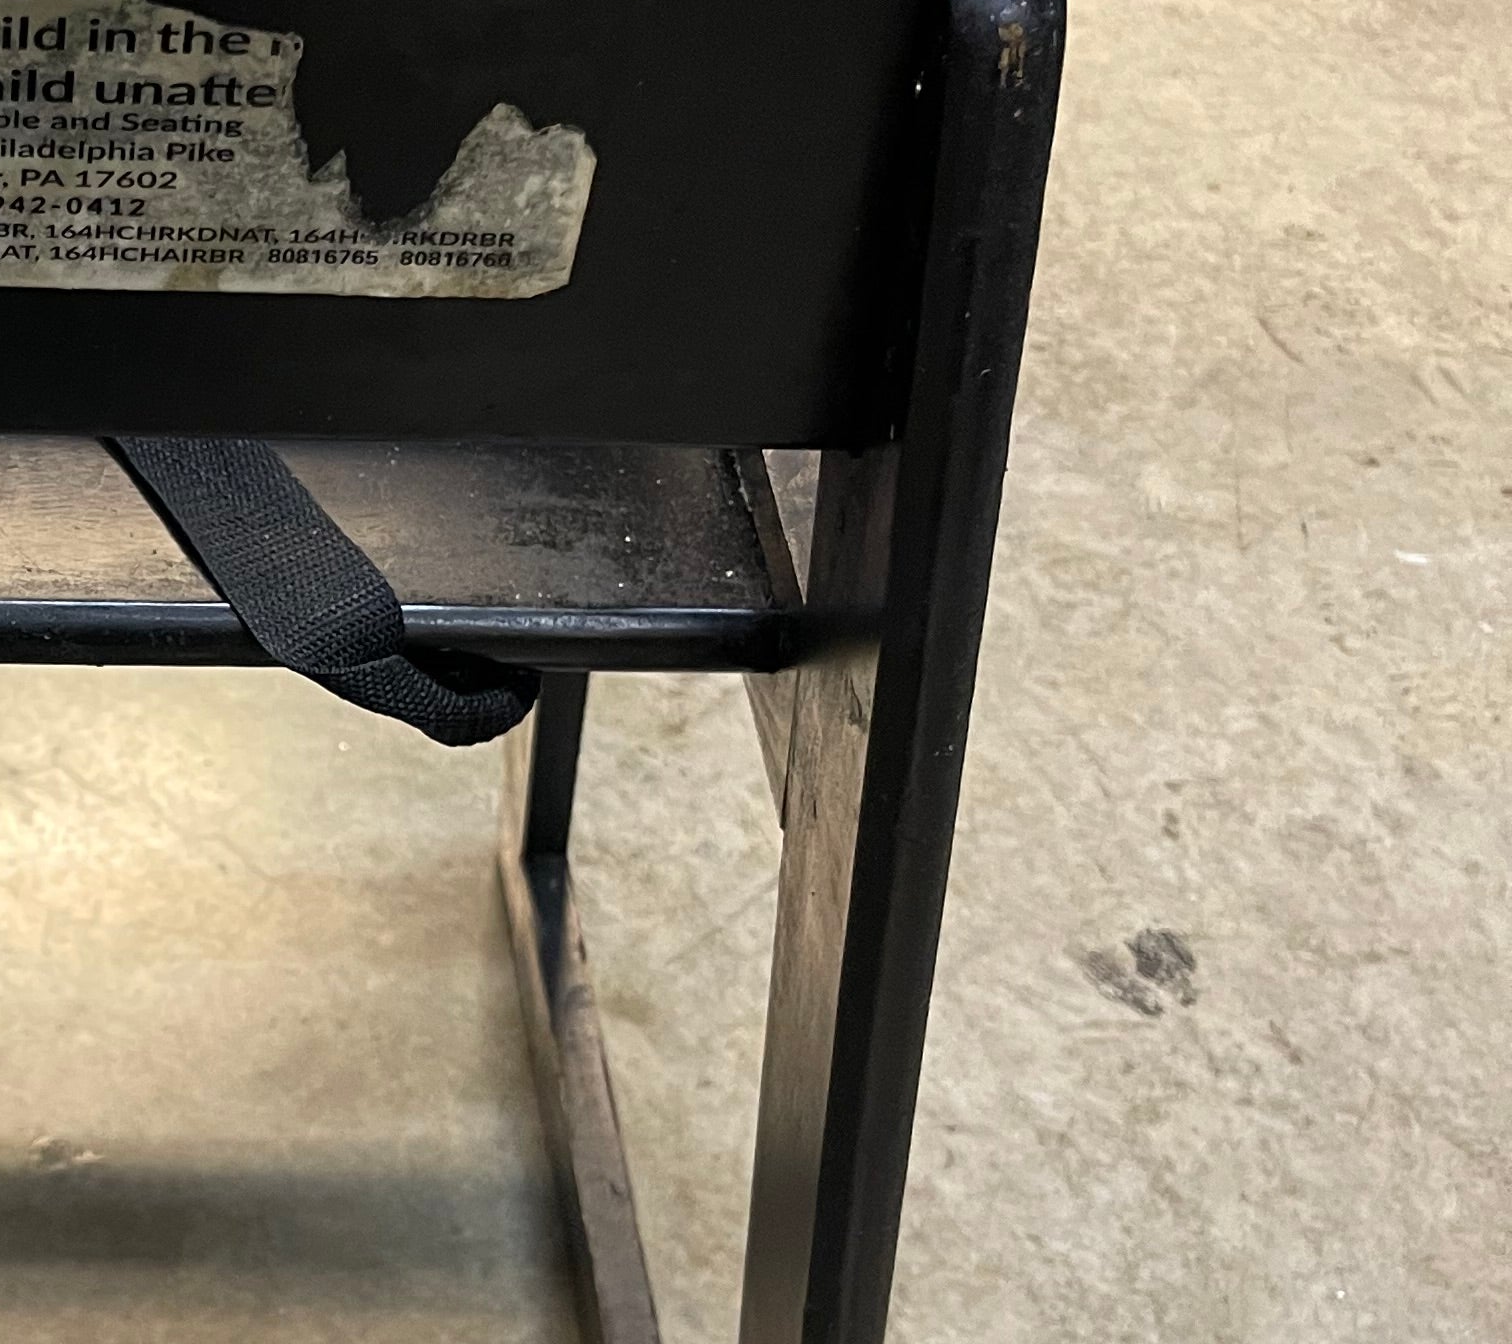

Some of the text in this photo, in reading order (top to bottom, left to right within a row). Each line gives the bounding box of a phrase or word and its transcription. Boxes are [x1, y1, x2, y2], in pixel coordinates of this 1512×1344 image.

[89, 18, 136, 53] in
[158, 20, 251, 56] the
[95, 75, 287, 108] unatte
[49, 110, 110, 132] and
[121, 113, 245, 138] Seating
[166, 142, 236, 163] Pike
[21, 168, 65, 188] PA
[76, 170, 178, 190] 17602
[45, 223, 279, 245] 164HCHRKDNAT,
[289, 227, 516, 248] 164HRKDRBR
[49, 245, 245, 264] 164HCHAIRBR
[268, 248, 379, 266] 80816765
